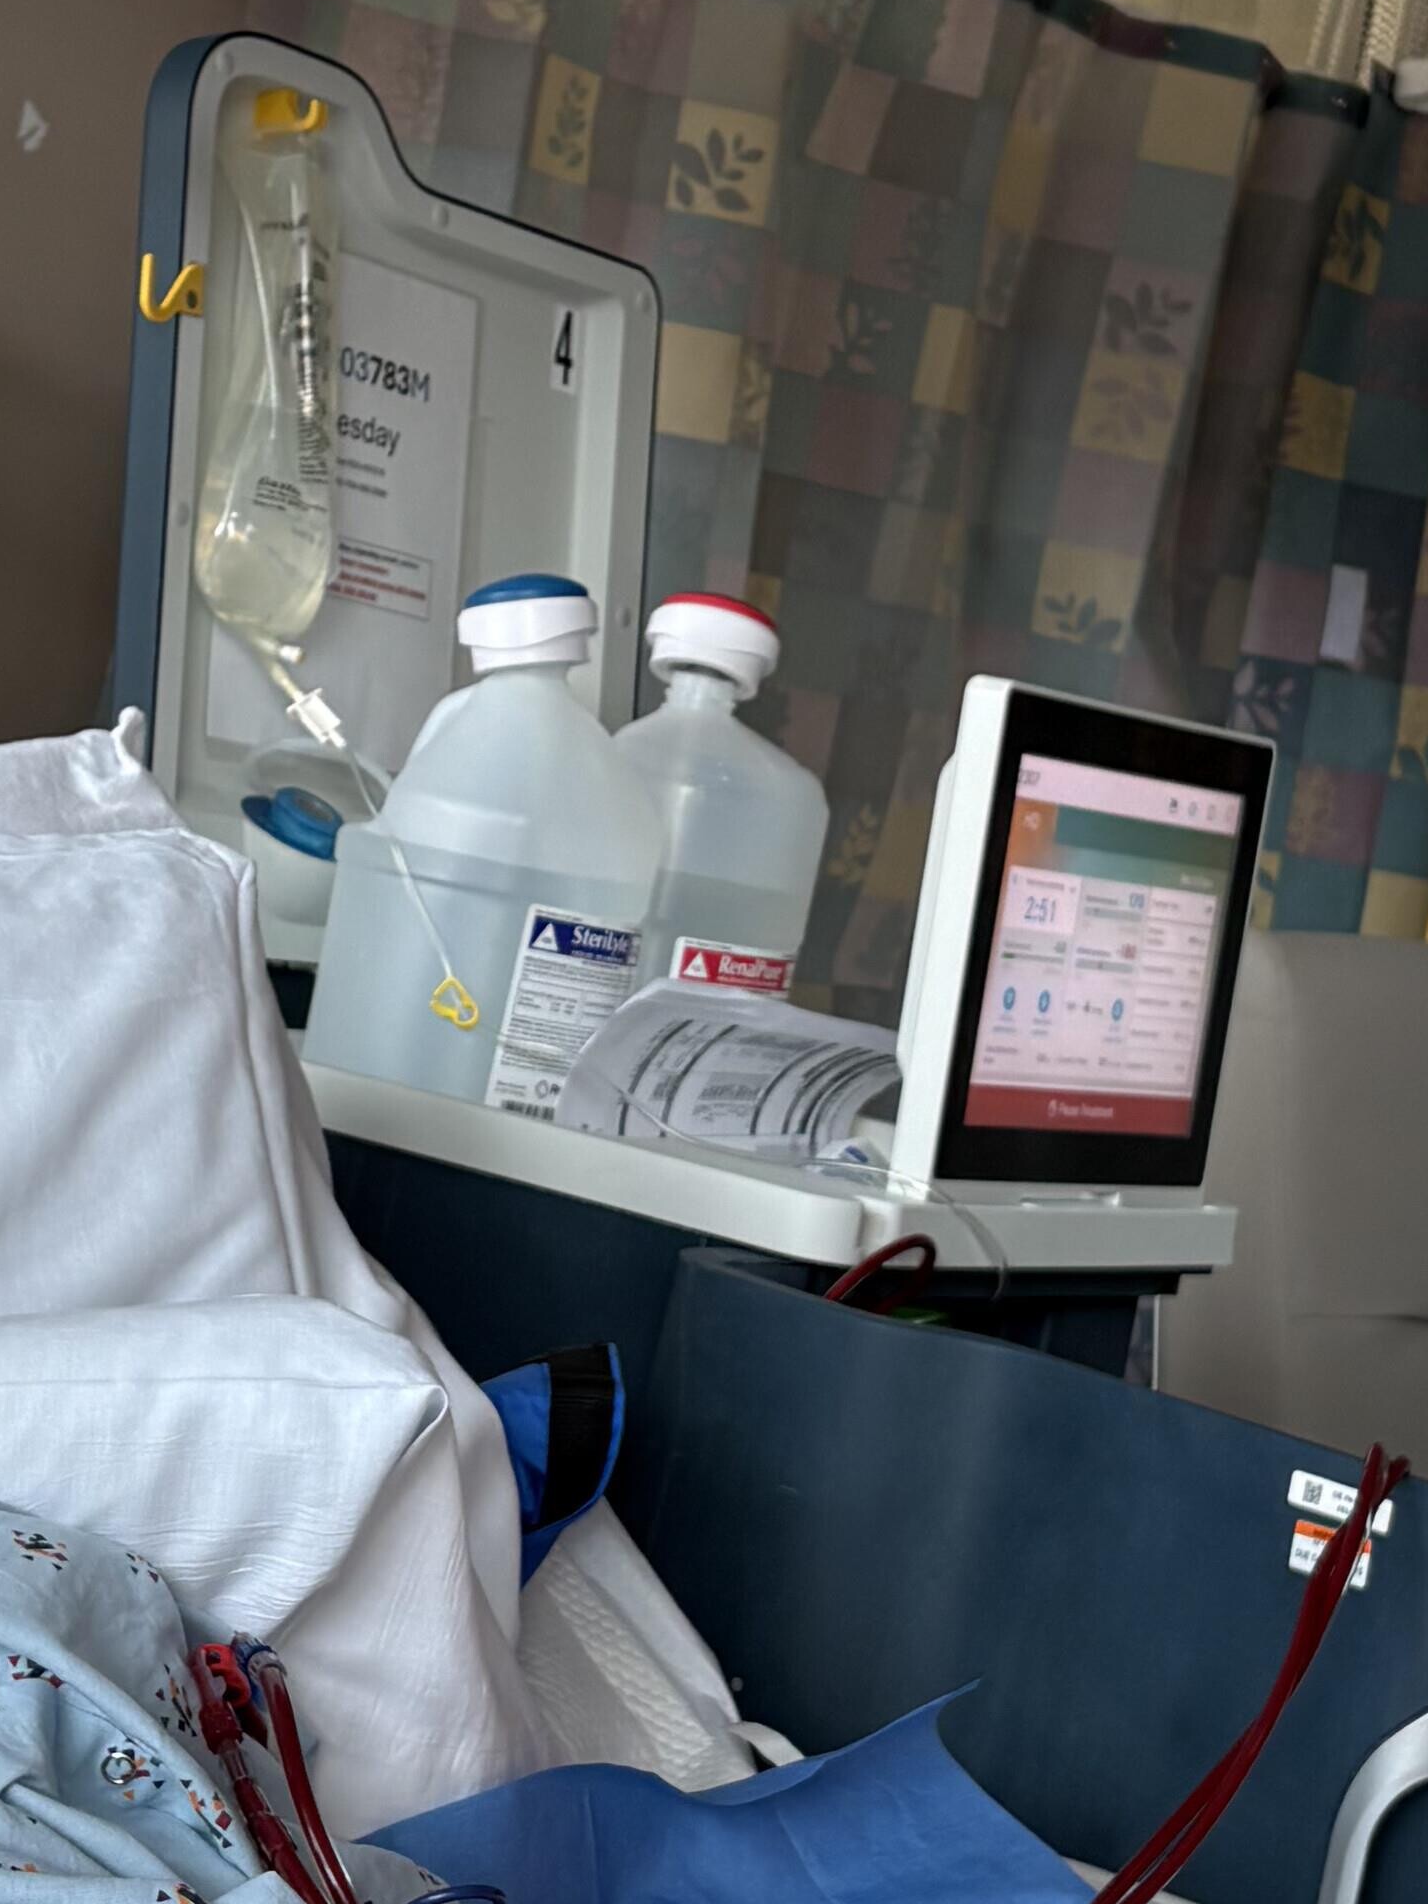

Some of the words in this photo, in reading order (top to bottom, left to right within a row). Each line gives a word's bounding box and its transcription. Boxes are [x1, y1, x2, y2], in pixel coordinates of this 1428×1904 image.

[552, 308, 575, 386] 4
[336, 413, 401, 457] esday
[1023, 895, 1058, 924] 2:51
